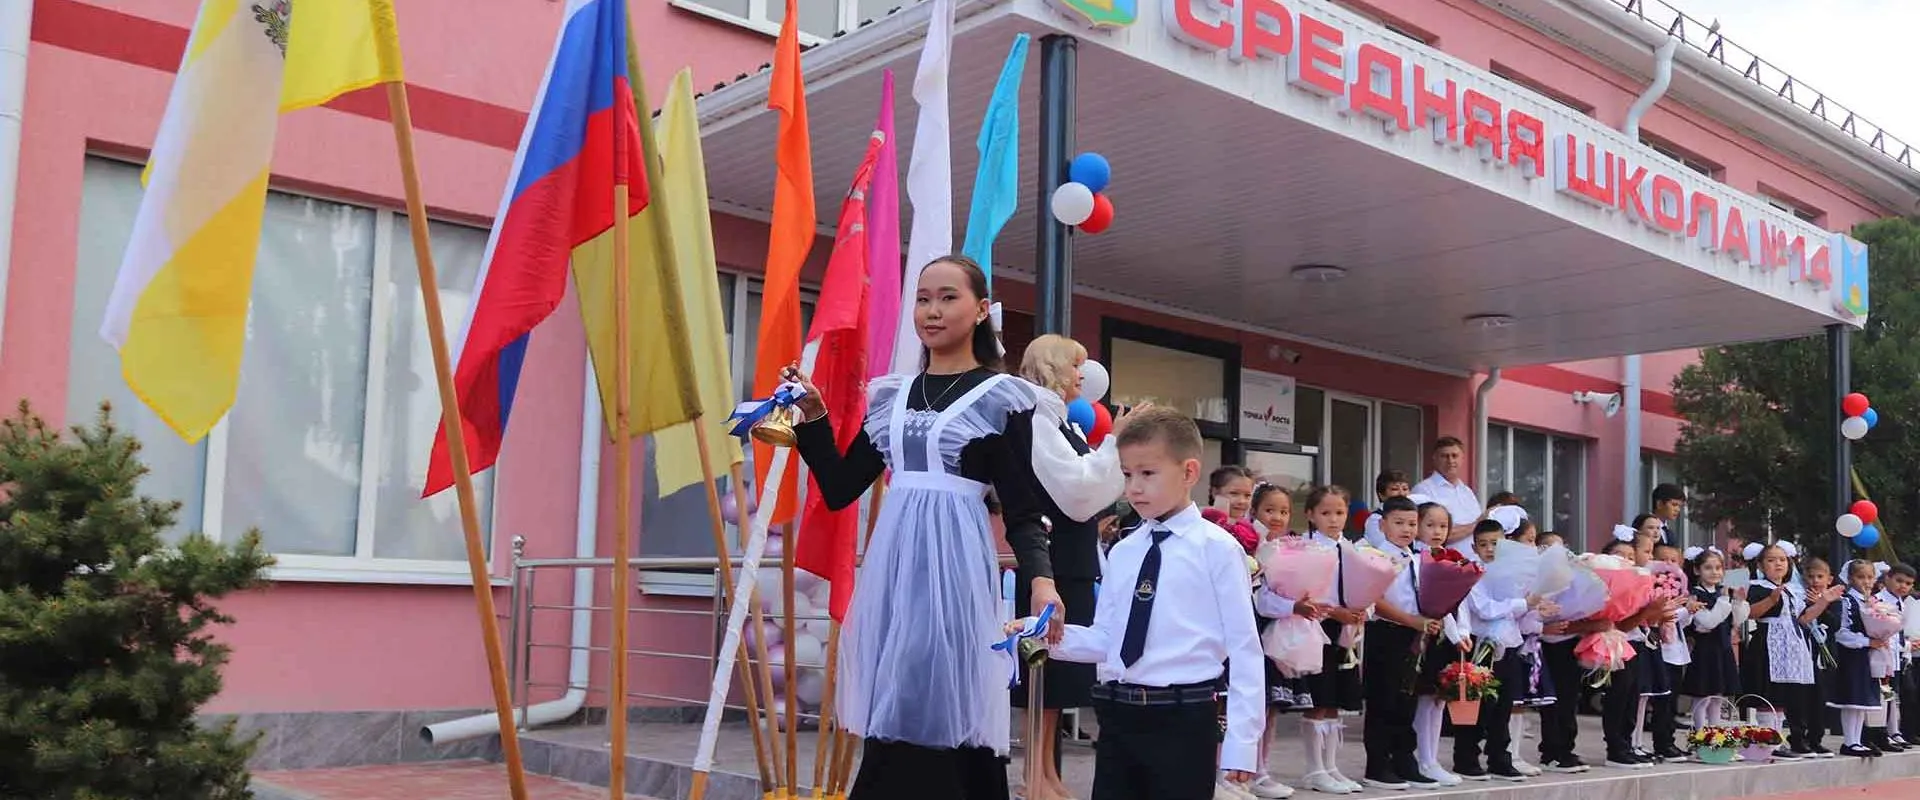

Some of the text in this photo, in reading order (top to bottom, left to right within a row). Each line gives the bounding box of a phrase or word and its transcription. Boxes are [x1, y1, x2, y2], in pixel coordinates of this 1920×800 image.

[1174, 0, 1832, 291] СРЕДНЯЯ ШКОЛА №14
